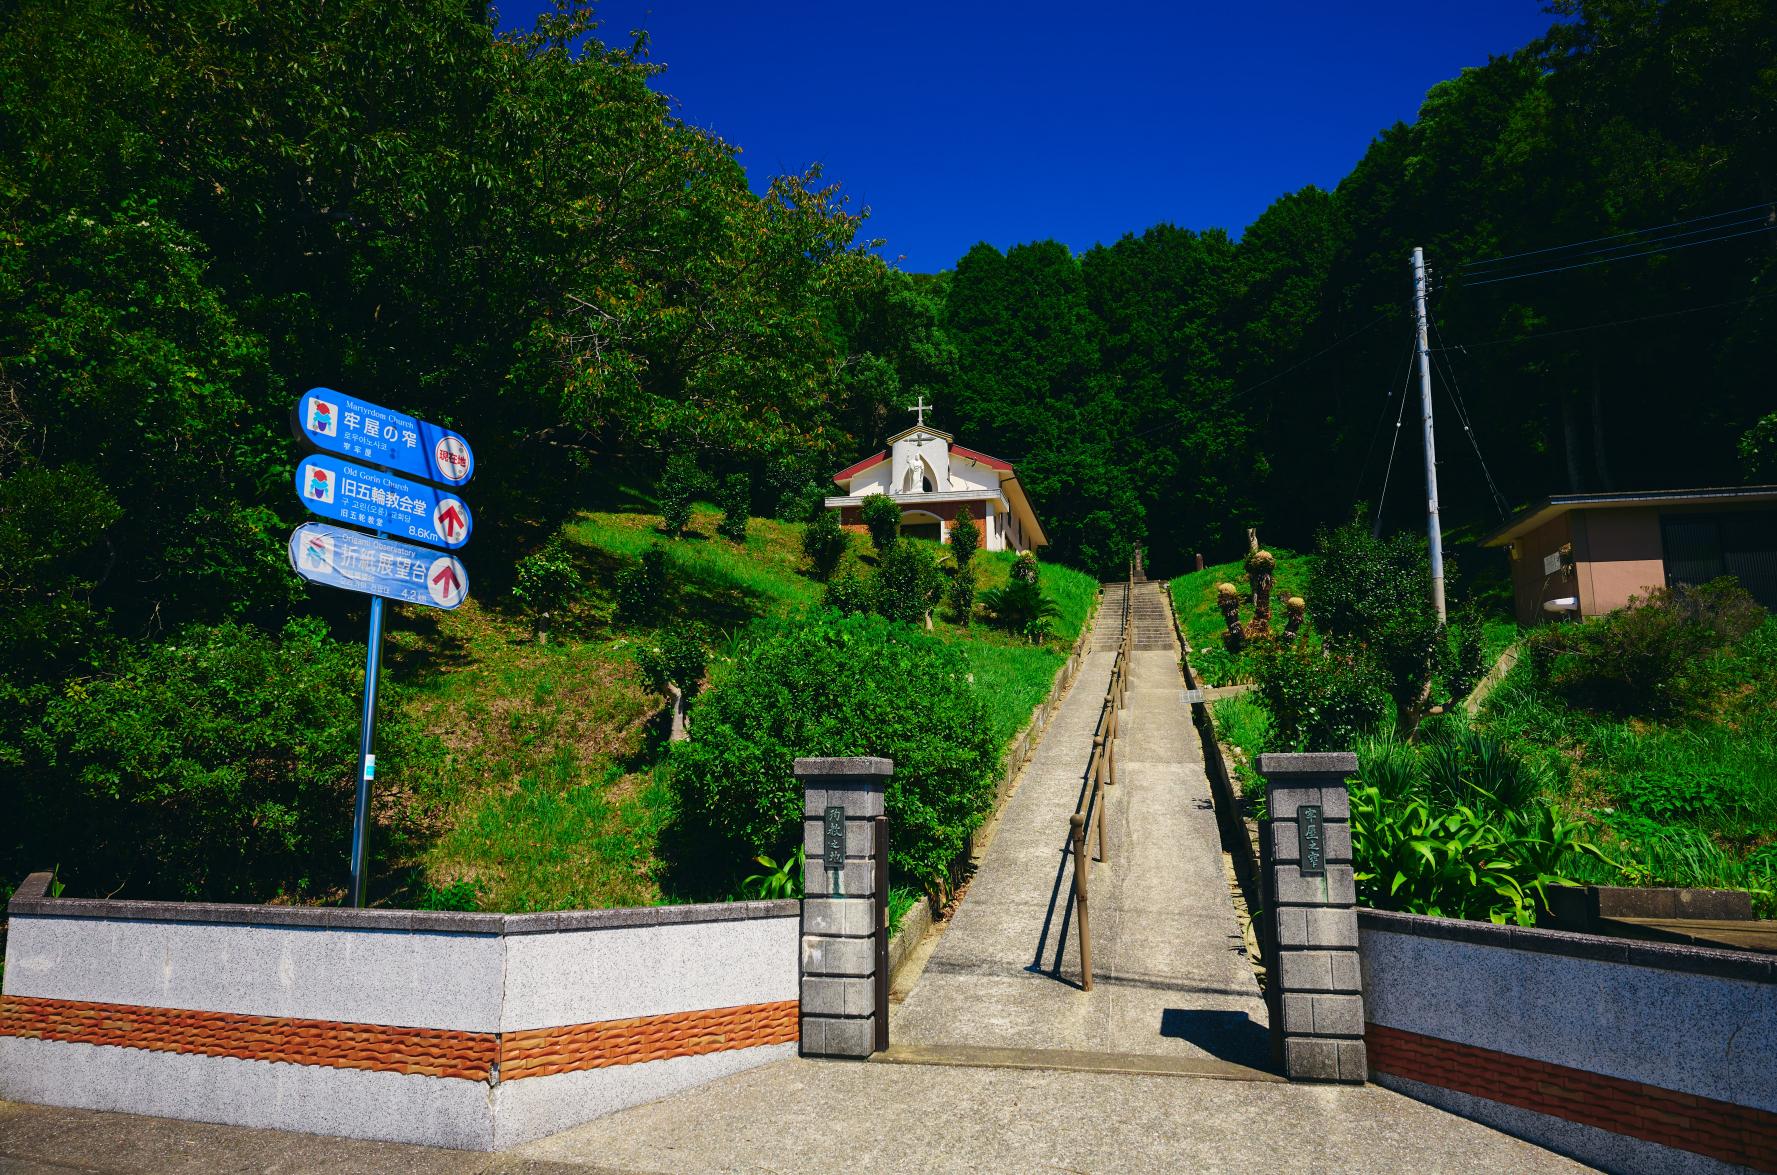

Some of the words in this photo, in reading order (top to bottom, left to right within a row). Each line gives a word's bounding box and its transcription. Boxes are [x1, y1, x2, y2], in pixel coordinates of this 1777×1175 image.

[346, 400, 387, 421] Martyrdom
[388, 414, 414, 430] Church
[343, 411, 417, 449] 牢屋の窄
[439, 448, 467, 468] 現在地
[343, 465, 358, 477] Old
[359, 471, 381, 485] Gorin
[382, 478, 409, 493] Church
[341, 477, 427, 517] 旧五輪教会堂
[408, 525, 438, 542] 8.6Km
[341, 543, 427, 583] 折紙展望台
[373, 541, 417, 558] Observatory
